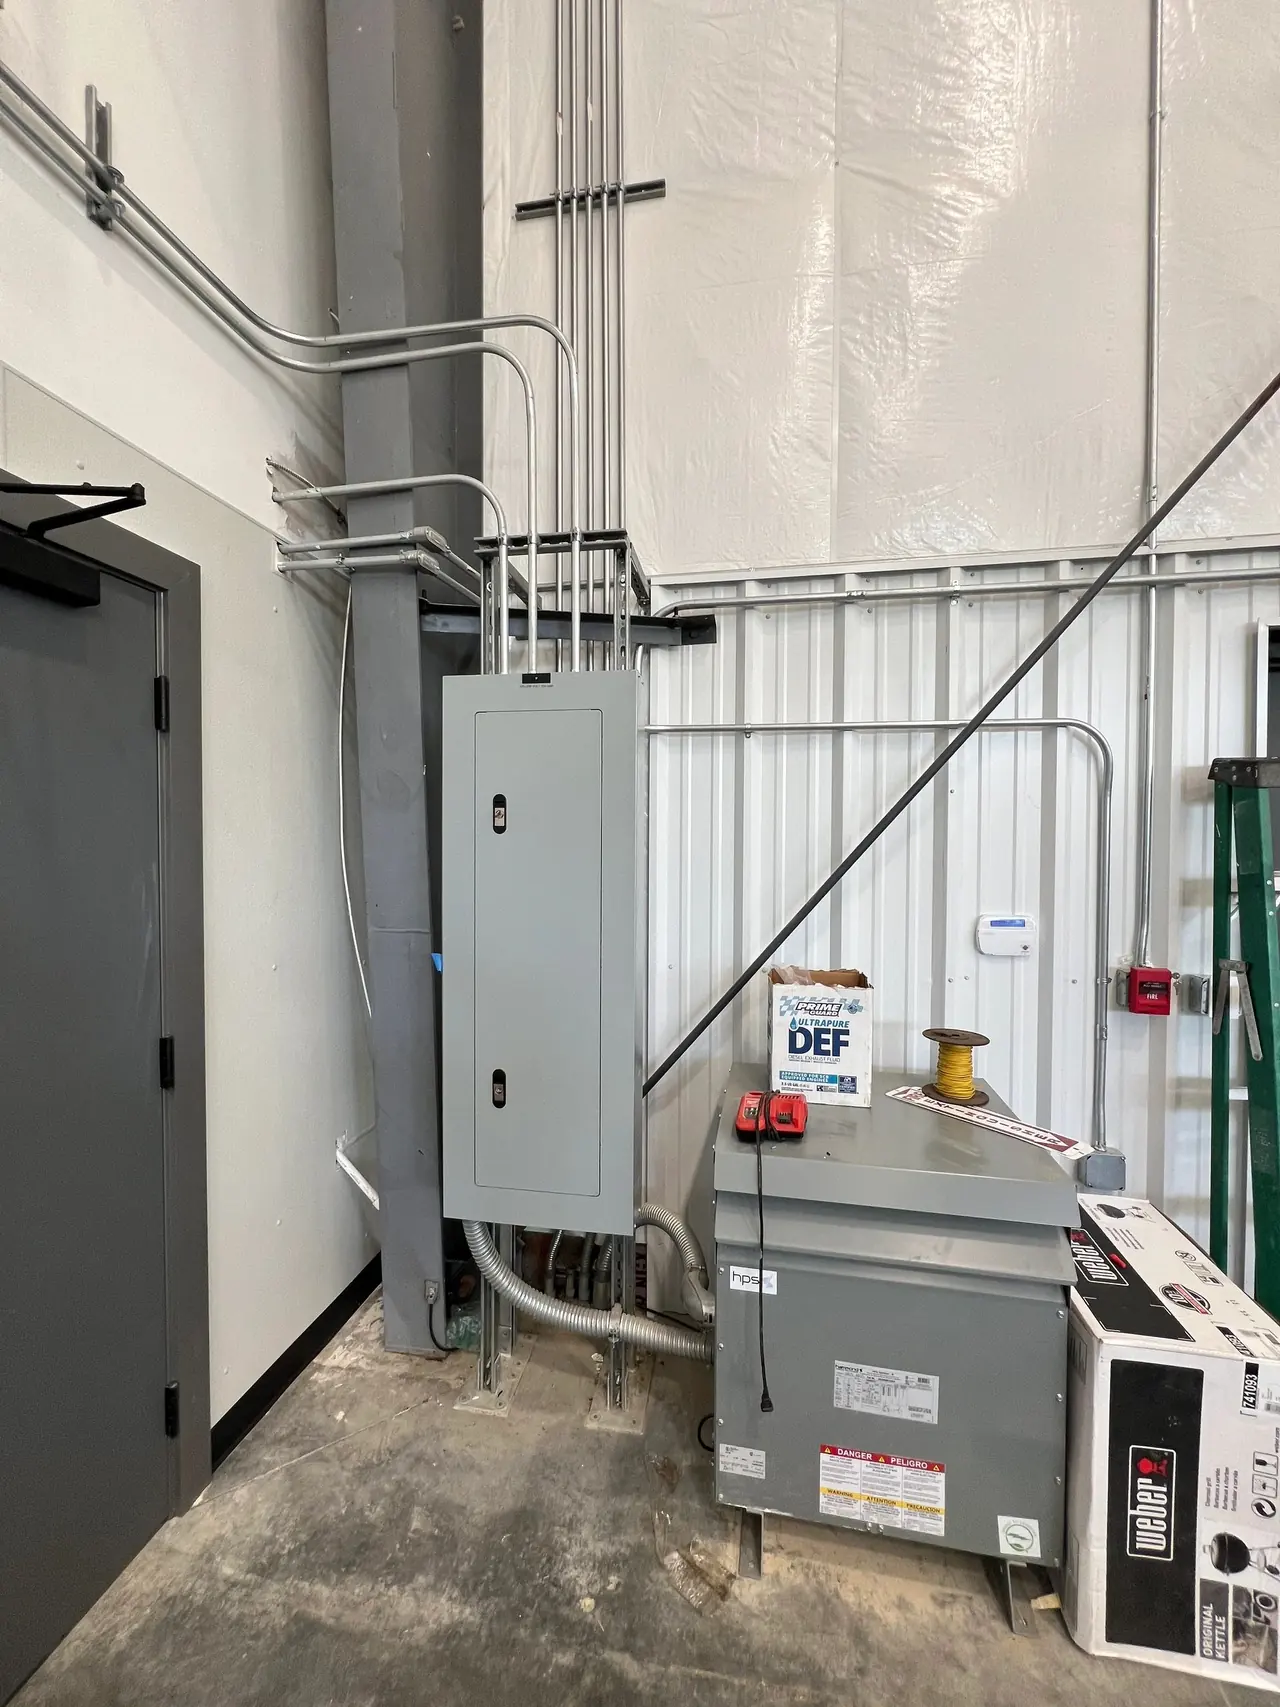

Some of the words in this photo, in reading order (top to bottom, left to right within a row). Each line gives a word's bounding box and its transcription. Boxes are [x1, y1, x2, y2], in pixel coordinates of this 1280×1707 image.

[797, 1002, 841, 1012] PRIME
[798, 1018, 850, 1028] ULTRAPURE
[788, 1026, 850, 1056] DEF
[924, 1098, 1061, 1146] EXTINGUISHER
[1071, 1240, 1118, 1280] weber
[732, 1271, 759, 1286] hps
[1242, 1374, 1258, 1409] 741093
[837, 1448, 873, 1461] DANGER
[890, 1457, 928, 1469] PELIGRO
[827, 1489, 853, 1498] WARNING
[866, 1496, 897, 1506] ATTENTION
[1129, 1477, 1168, 1551] weber
[1202, 1602, 1214, 1656] ORIGINAL
[1214, 1614, 1226, 1659] KETTLE
